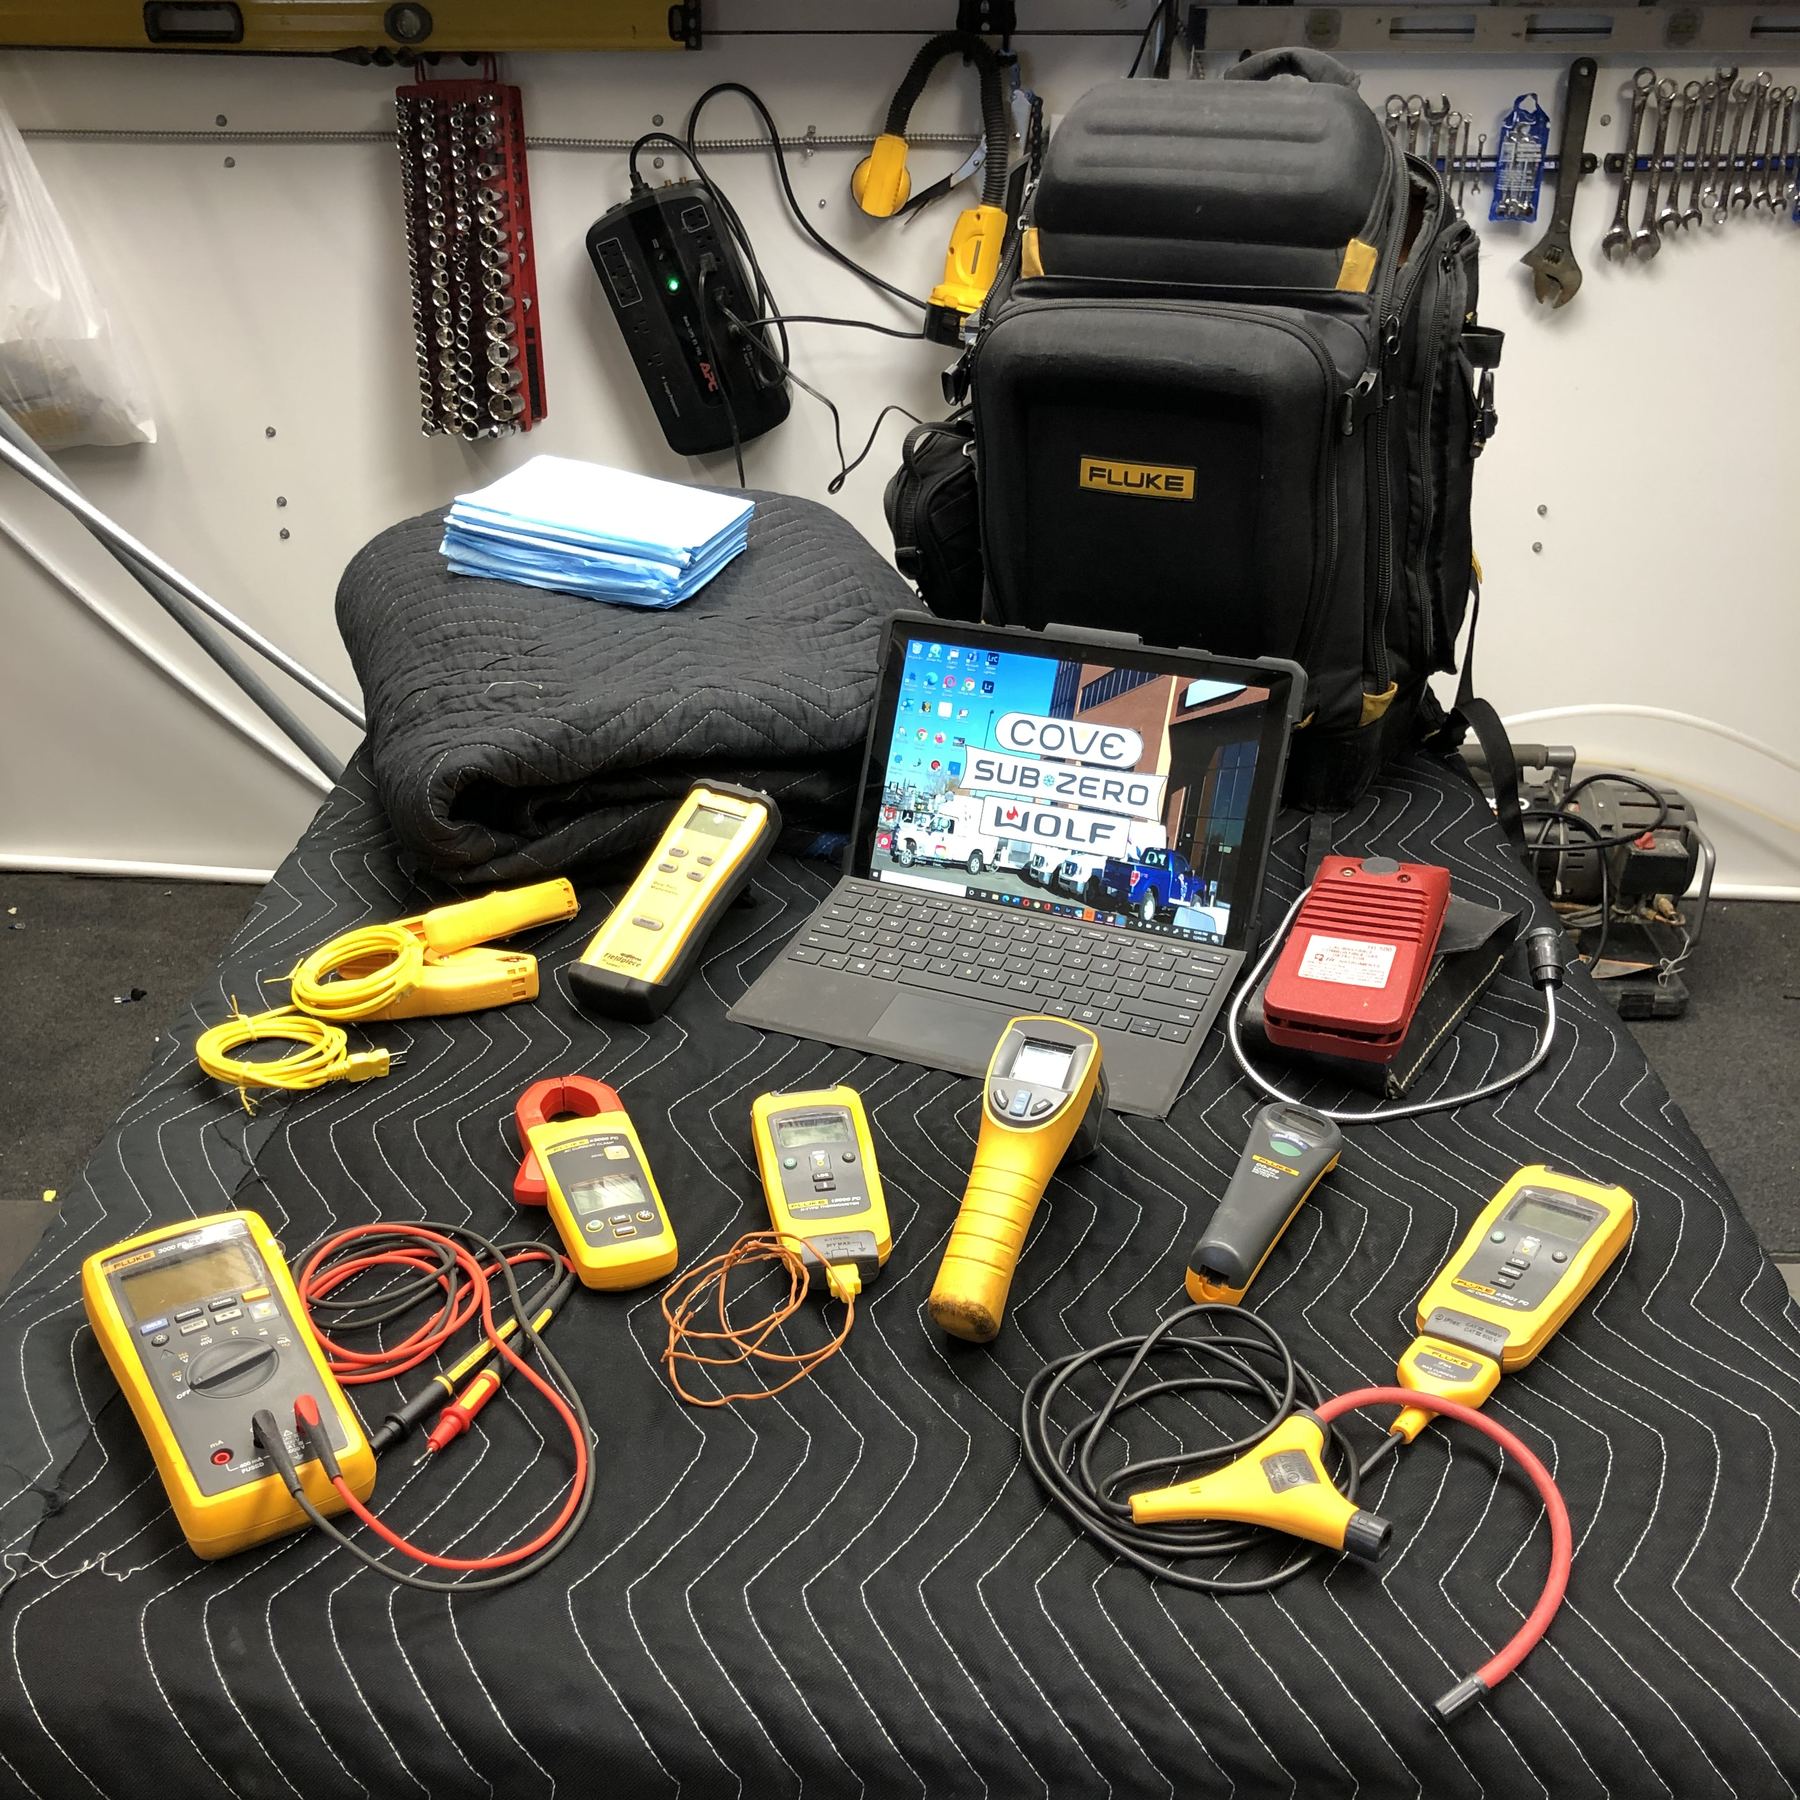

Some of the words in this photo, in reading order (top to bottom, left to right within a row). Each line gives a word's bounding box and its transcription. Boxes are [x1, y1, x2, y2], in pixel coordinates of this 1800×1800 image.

[700, 362, 719, 392] APC
[1089, 466, 1184, 492] FLUKE
[1010, 719, 1126, 760] COVE
[974, 759, 1041, 788] SUB
[1056, 772, 1149, 806] ZERO
[994, 806, 1116, 844] WOLF
[113, 1253, 152, 1269] FLUKE
[158, 1244, 176, 1255] 3000
[1457, 1280, 1494, 1294] FLUKE
[1431, 1352, 1469, 1367] FLUKE
[176, 1389, 191, 1400] OFF
[210, 1439, 224, 1448] mA
